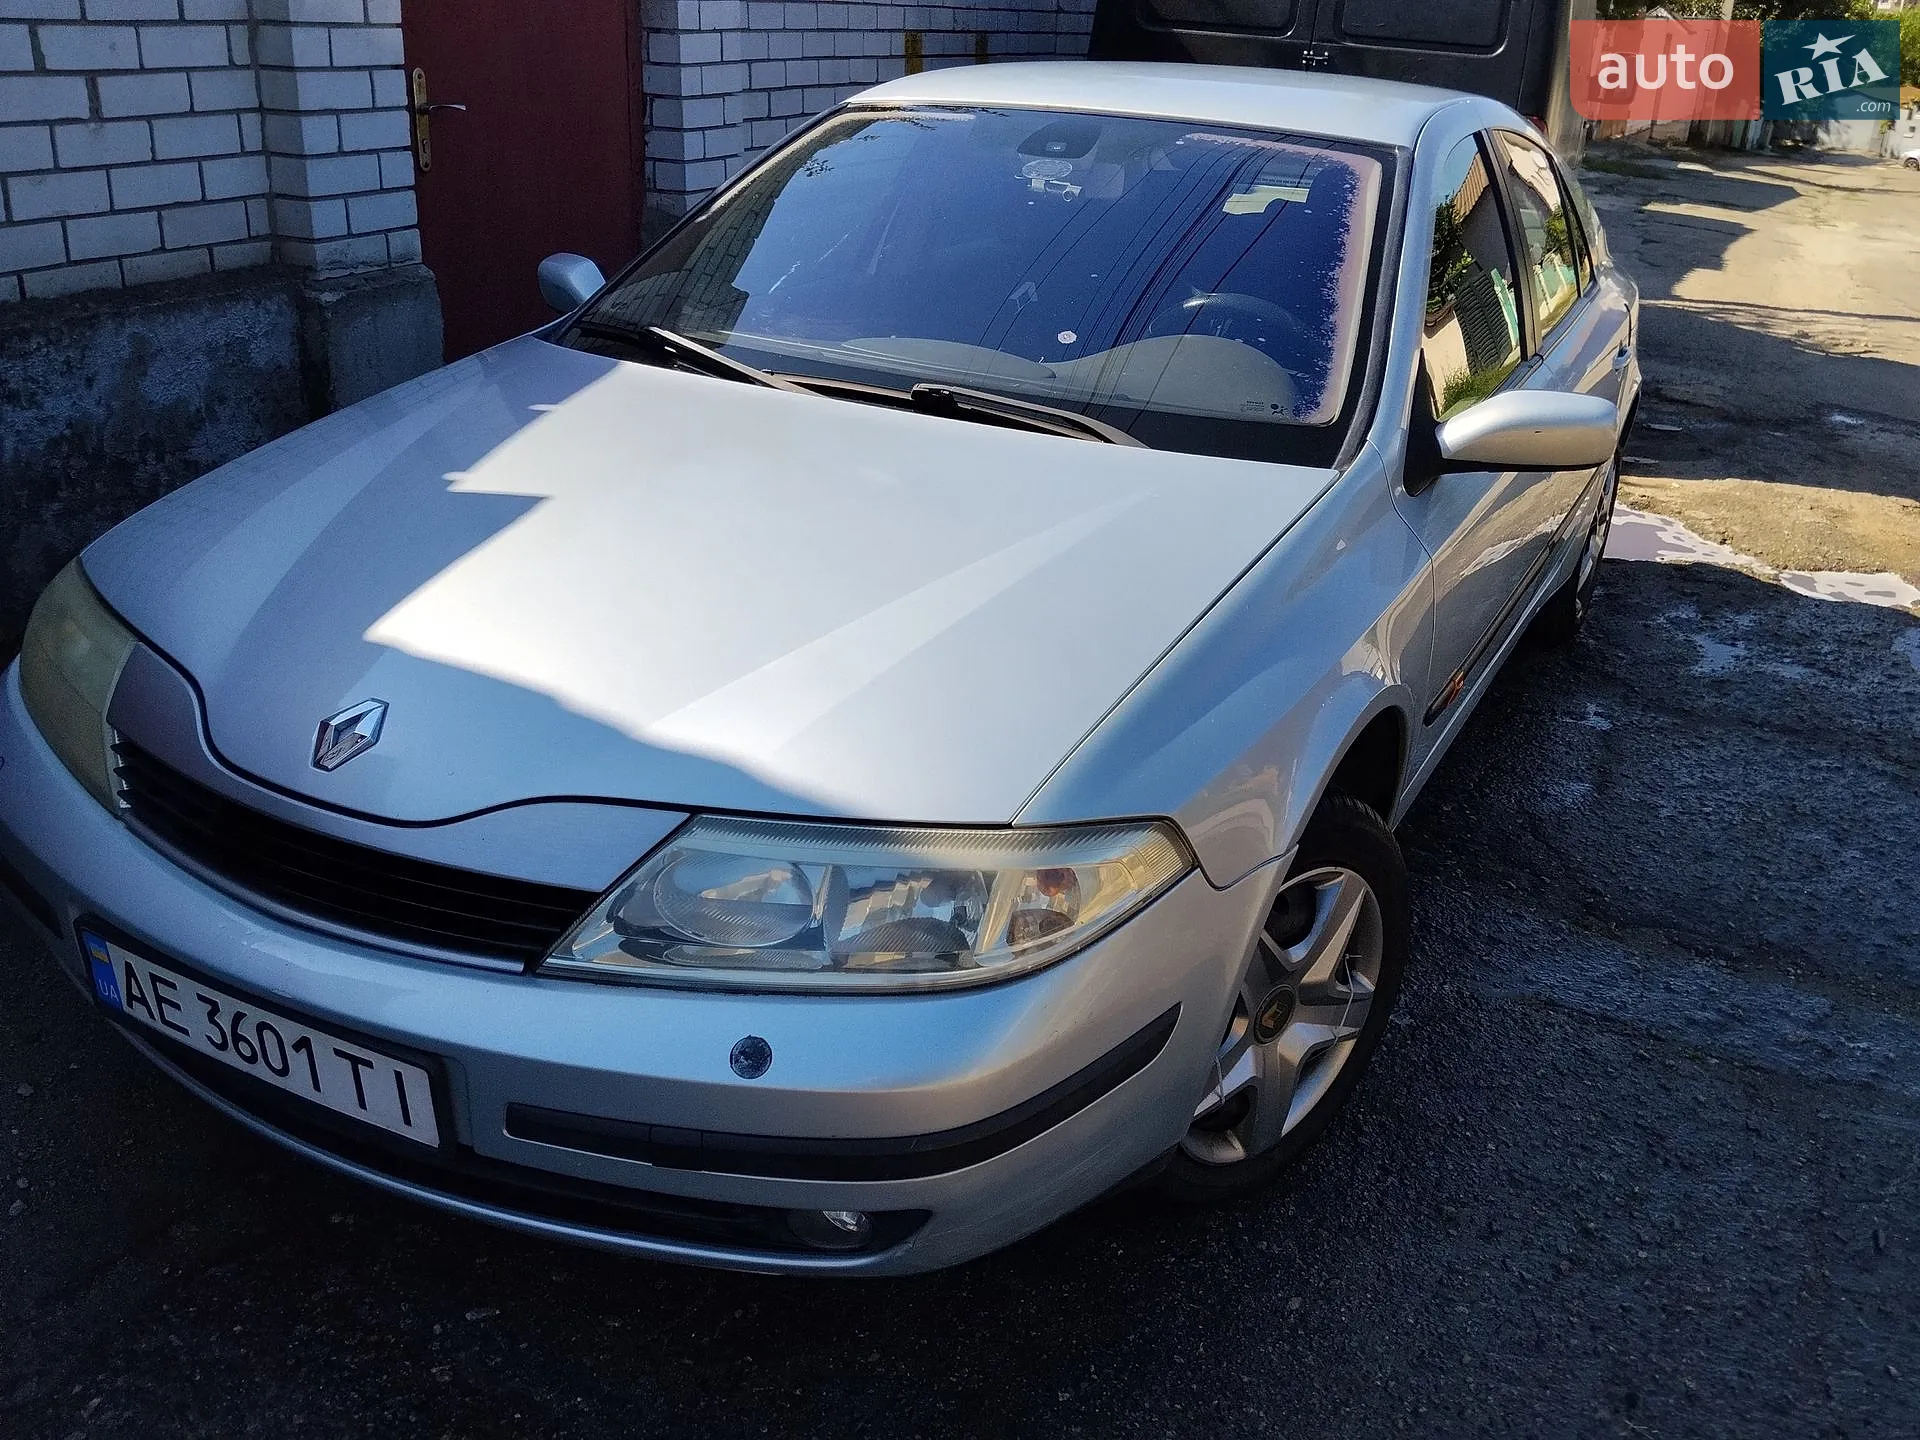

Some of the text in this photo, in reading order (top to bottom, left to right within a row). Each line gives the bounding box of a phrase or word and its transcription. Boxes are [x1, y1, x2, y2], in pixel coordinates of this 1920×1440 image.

[98, 977, 119, 1000] UA
[122, 960, 412, 1128] AE 3601 TI
